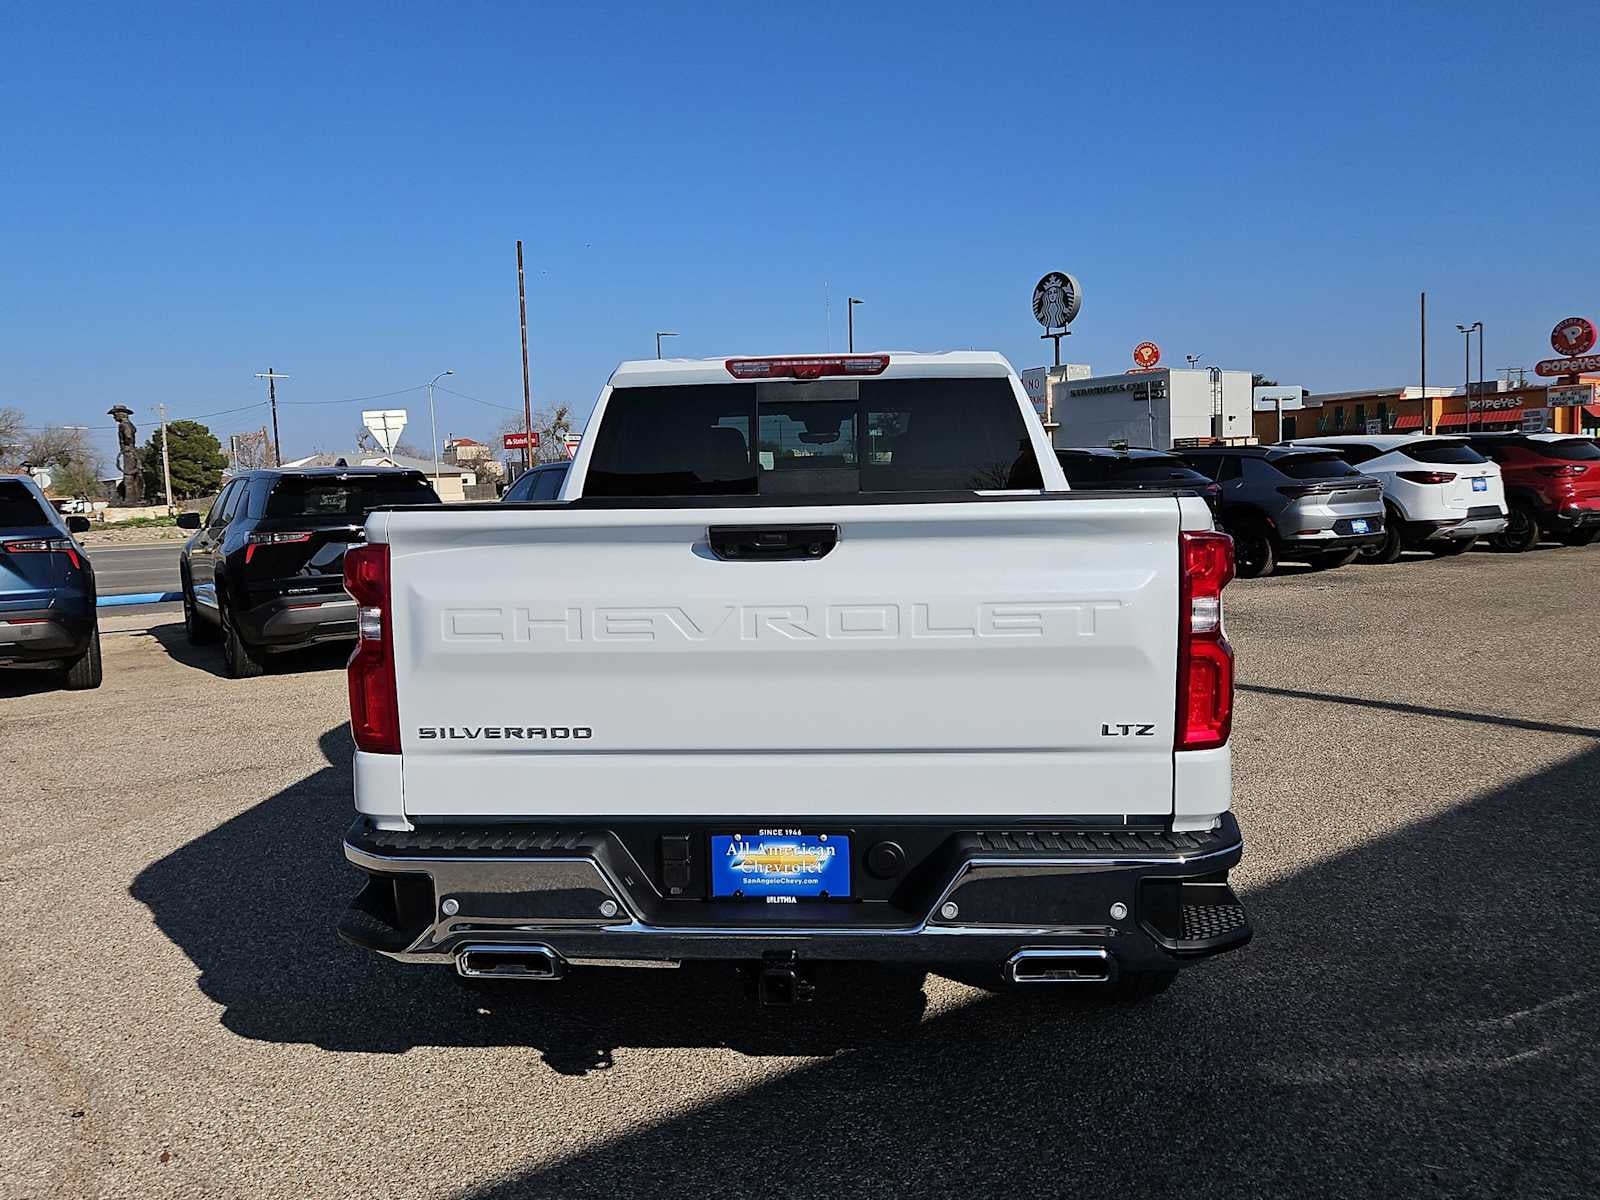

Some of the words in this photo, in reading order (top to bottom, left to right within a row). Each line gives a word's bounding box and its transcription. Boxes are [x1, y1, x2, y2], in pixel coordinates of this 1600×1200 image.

[1028, 379, 1040, 390] NO
[440, 600, 1123, 641] CHEVROLET
[418, 727, 593, 739] SILVERADO
[1101, 723, 1156, 736] LTZ
[726, 842, 749, 856] All
[757, 842, 836, 857] American
[741, 859, 823, 874] Chevrolet
[742, 877, 819, 886] SanAngeloChevy.com
